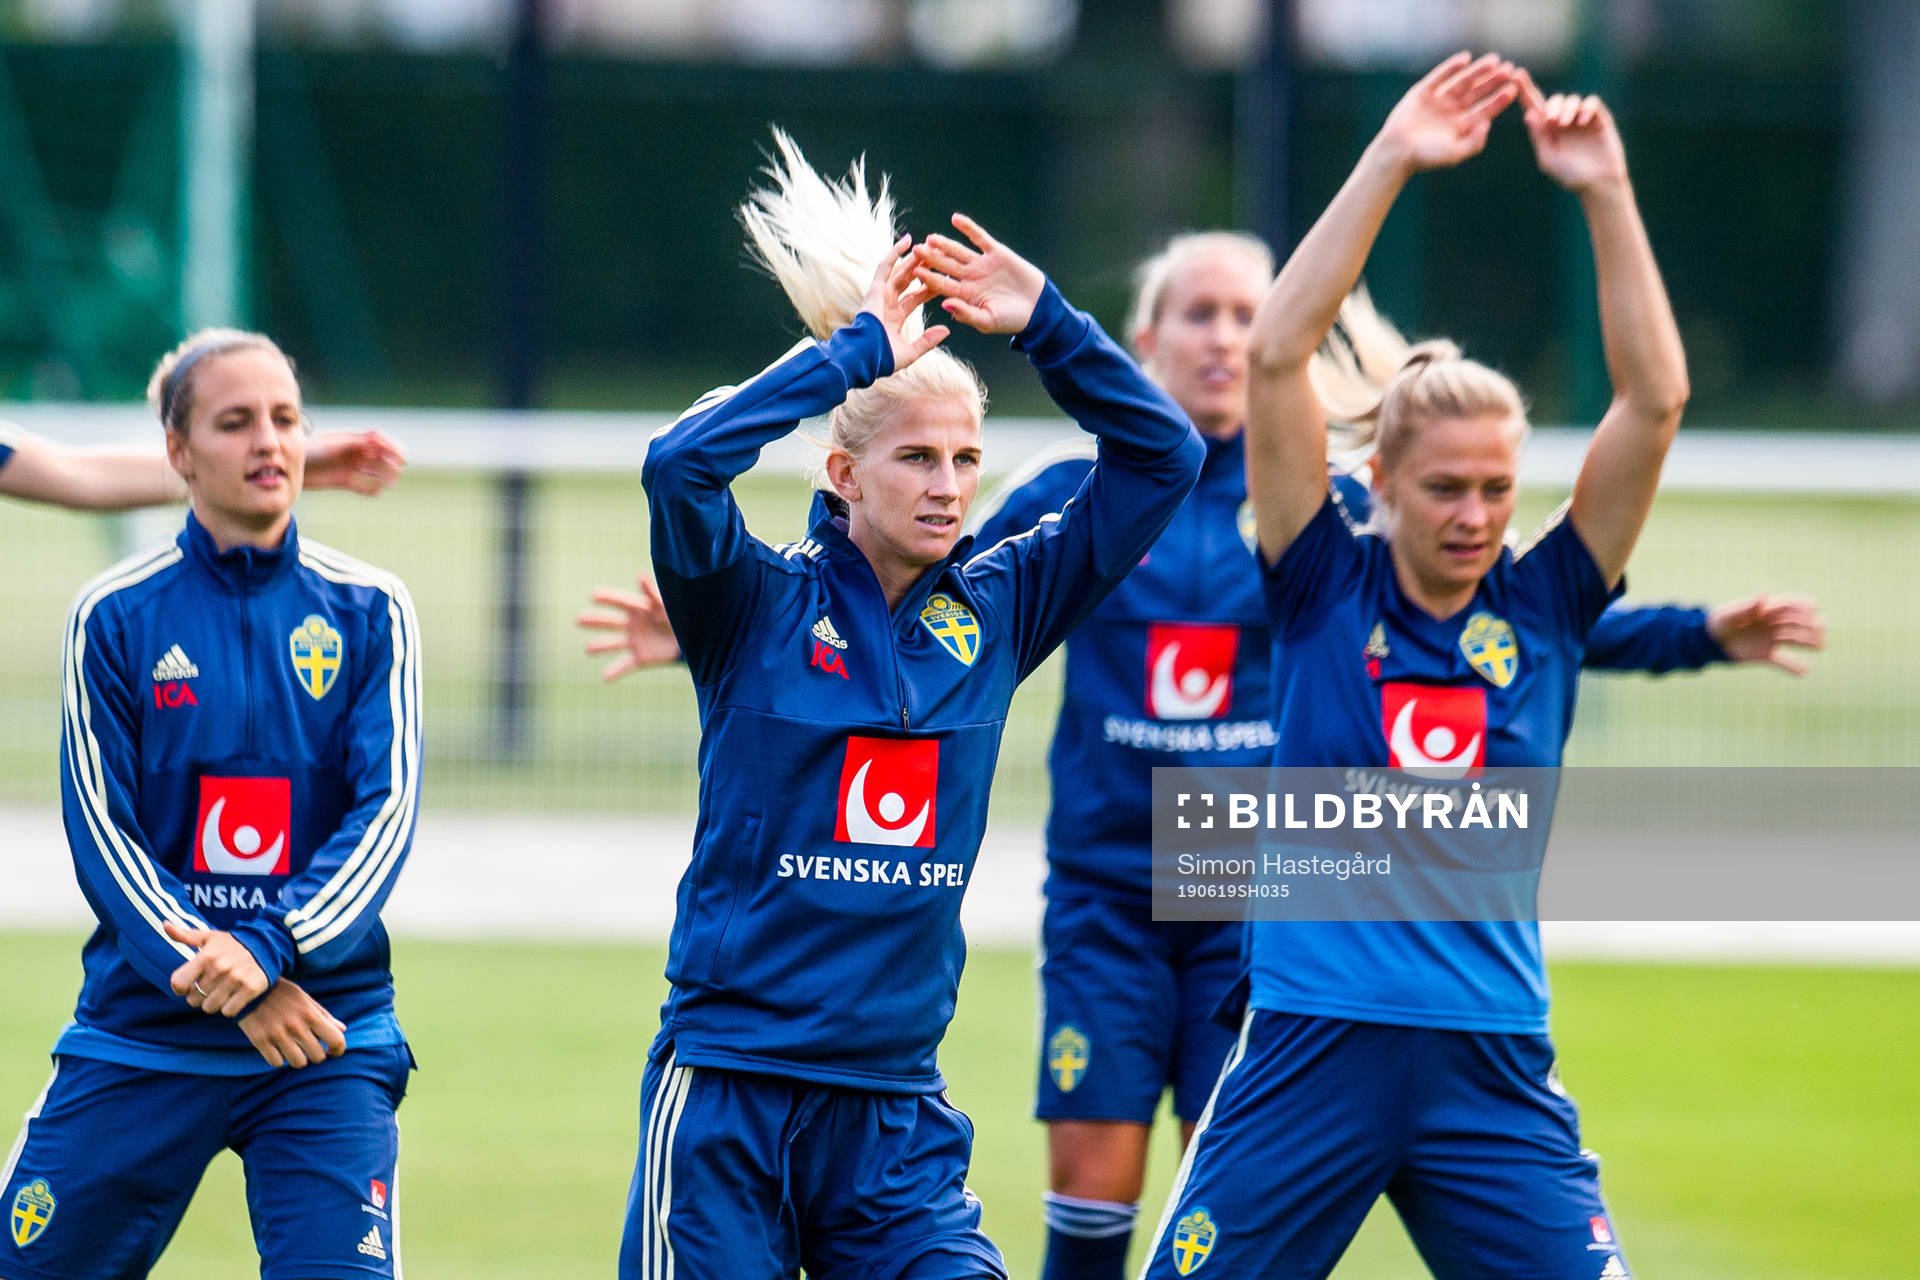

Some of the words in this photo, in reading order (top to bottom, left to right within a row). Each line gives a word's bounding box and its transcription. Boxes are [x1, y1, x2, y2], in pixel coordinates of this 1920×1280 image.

[152, 664, 200, 681] adidas
[811, 641, 849, 680] ICA
[153, 681, 199, 710] ICA
[777, 853, 912, 885] SVENSKA
[919, 863, 964, 887] SPEL
[184, 883, 267, 910] NSKA
